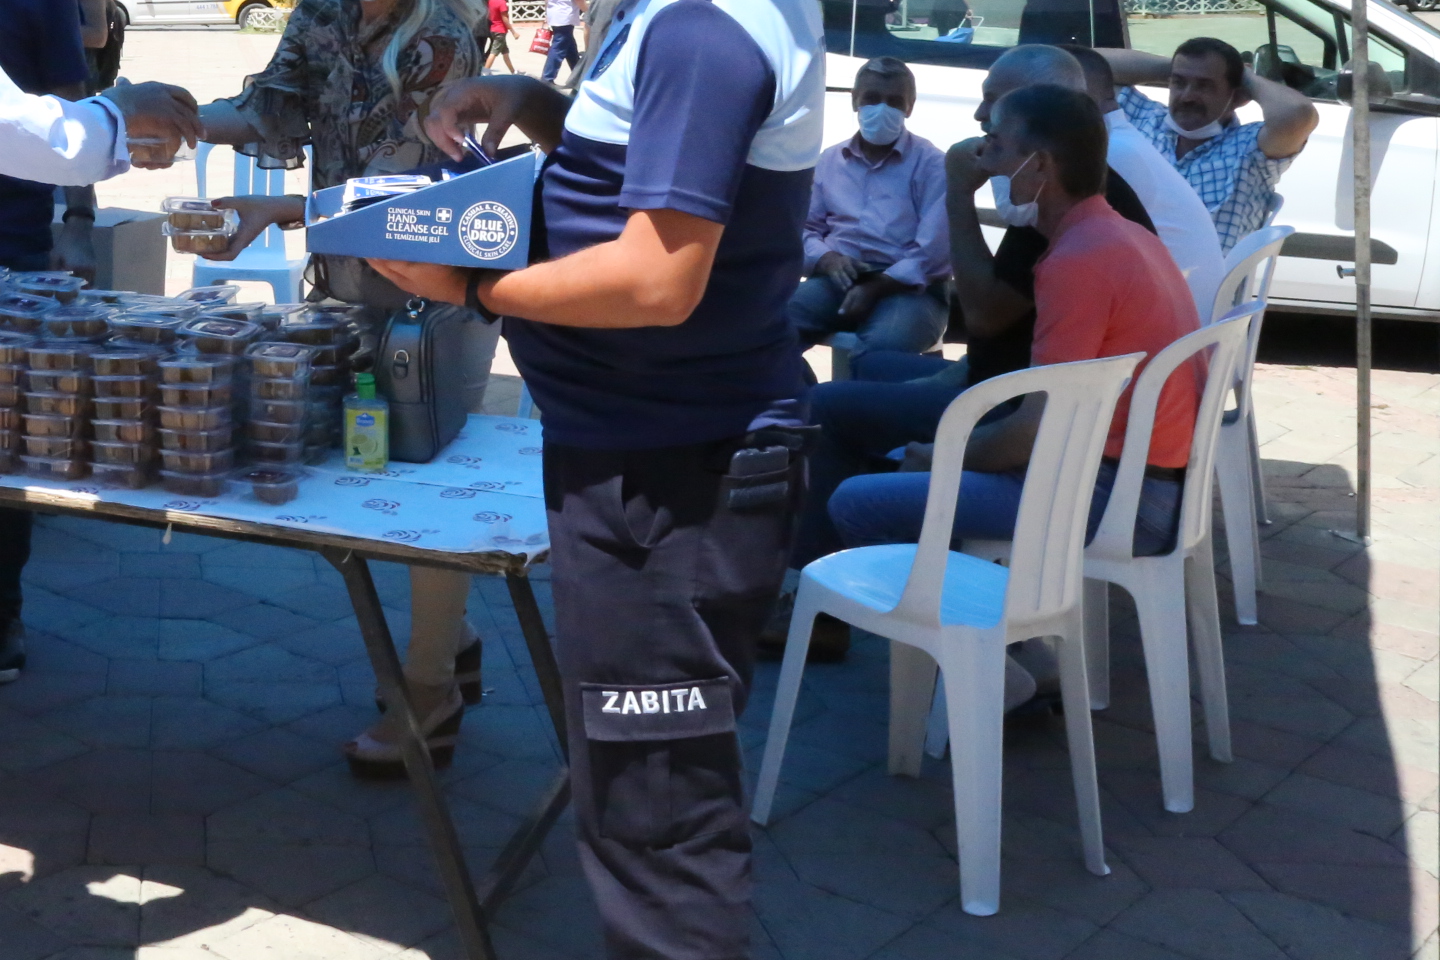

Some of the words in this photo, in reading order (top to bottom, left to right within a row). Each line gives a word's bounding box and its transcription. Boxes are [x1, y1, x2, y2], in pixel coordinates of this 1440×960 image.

[388, 207, 415, 215] CLINICAL
[462, 204, 484, 226] CASUAL
[492, 204, 516, 229] CREATIVE
[387, 214, 417, 224] HAND
[473, 219, 503, 231] BLUE
[386, 223, 429, 234] CLEANSE
[430, 225, 449, 235] GEL
[394, 233, 428, 242] TEMİZLEME
[470, 230, 505, 243] DROP
[462, 235, 483, 257] CLINICAL
[484, 249, 498, 257] SKIN
[498, 240, 512, 254] CARE
[601, 687, 707, 715] ZABITA
